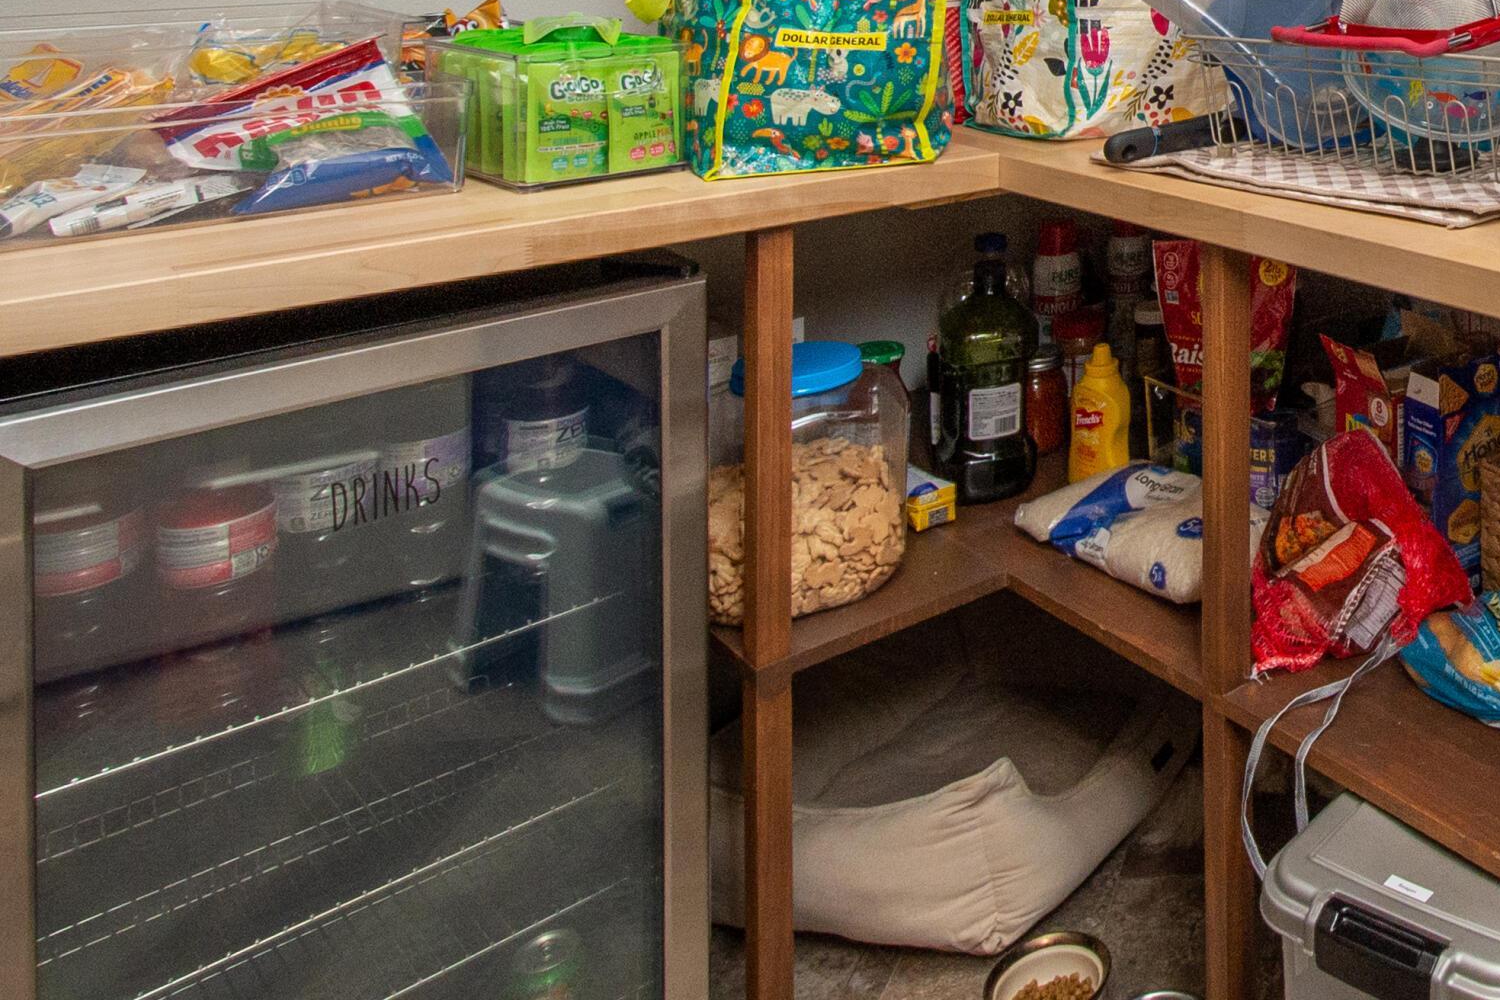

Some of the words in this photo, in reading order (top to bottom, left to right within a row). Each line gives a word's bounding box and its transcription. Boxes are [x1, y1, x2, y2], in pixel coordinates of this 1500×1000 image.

[782, 34, 828, 46] DOLLAR
[830, 35, 881, 46] GENERAL
[1075, 413, 1102, 426] French's
[1134, 472, 1160, 494] Long
[332, 458, 440, 532] DRINKS
